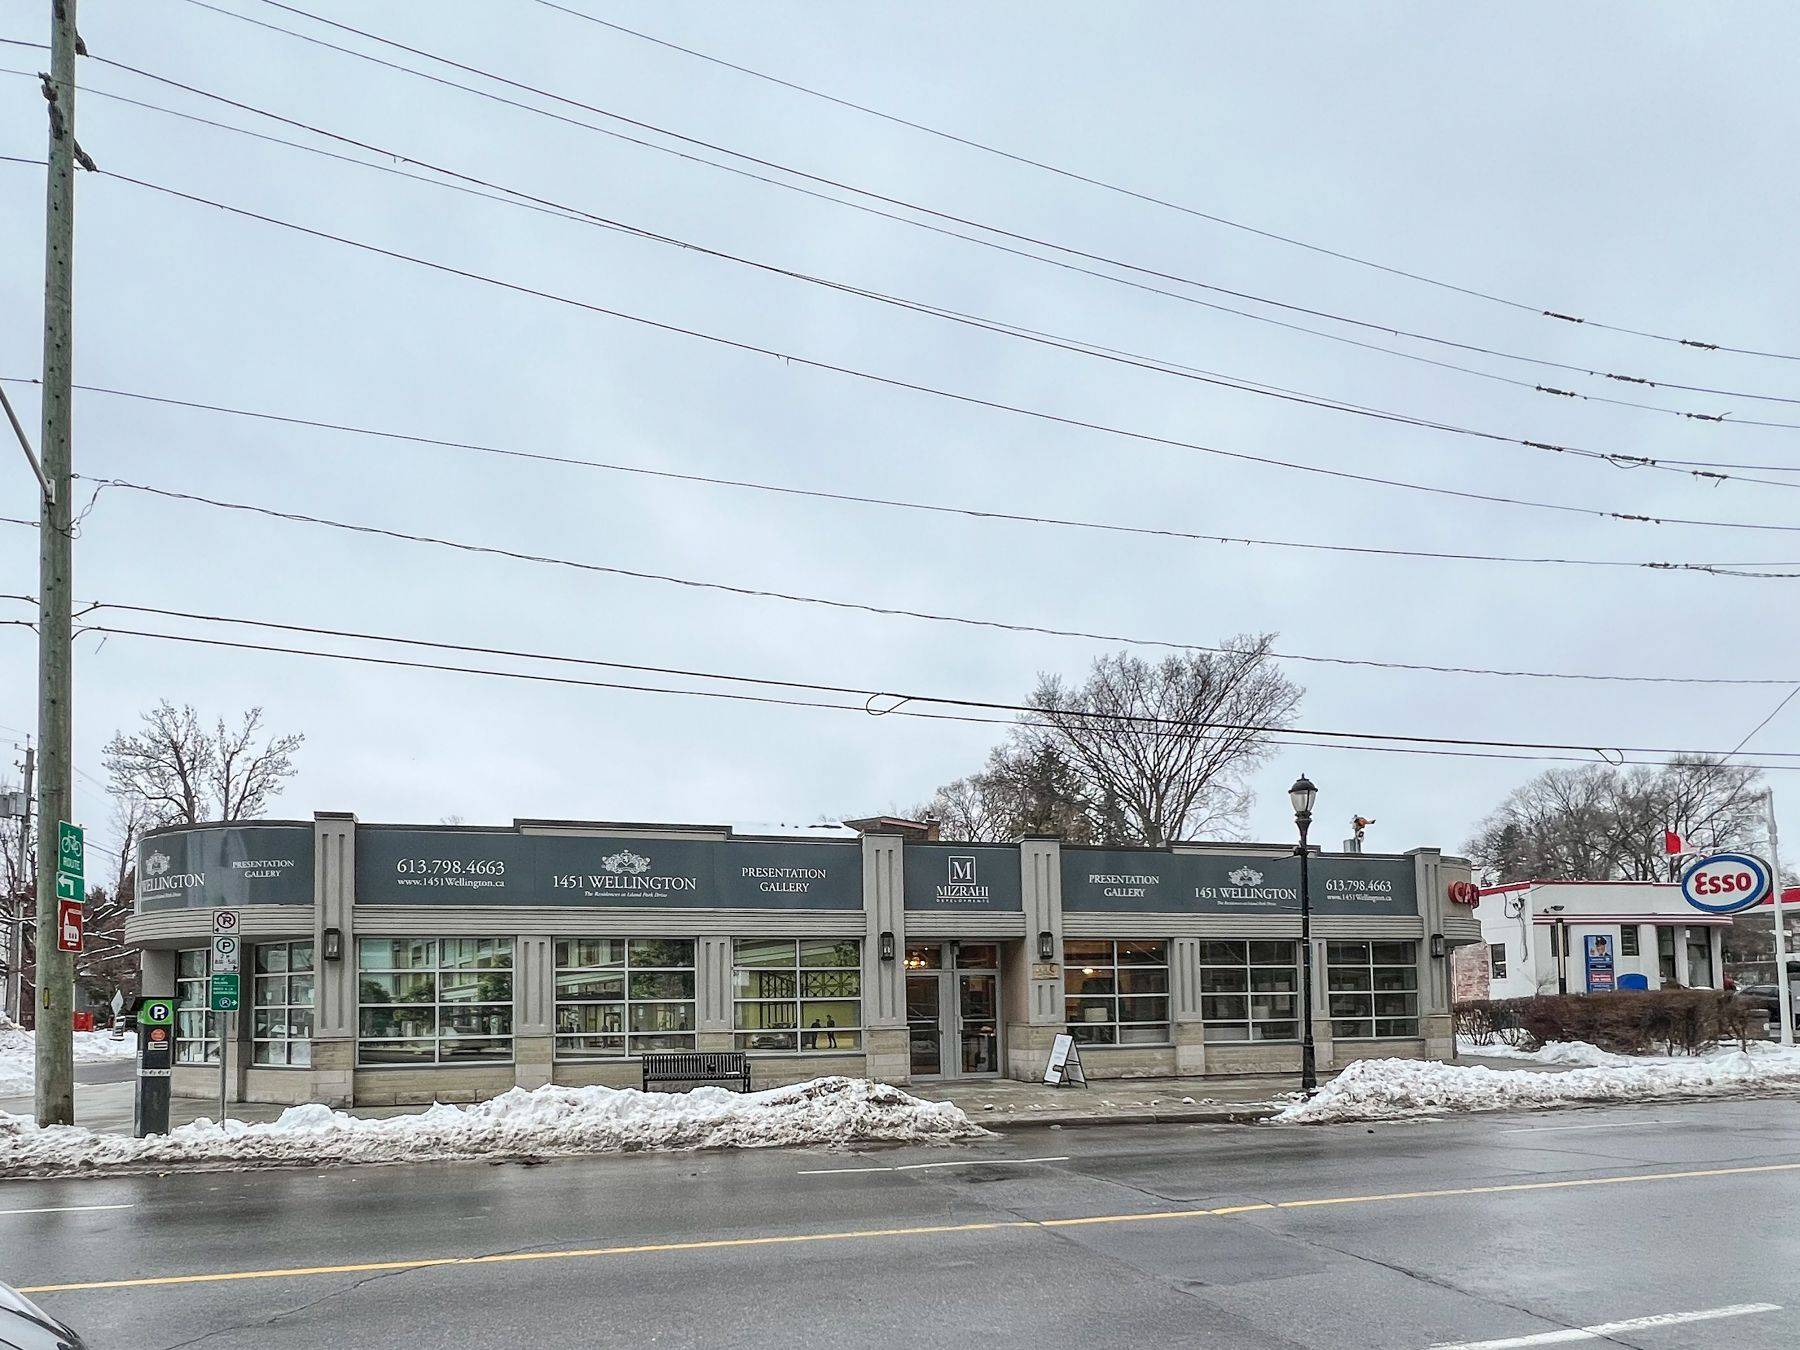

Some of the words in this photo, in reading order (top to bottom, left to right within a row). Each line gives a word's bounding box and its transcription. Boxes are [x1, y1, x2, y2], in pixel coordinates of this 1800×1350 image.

[232, 860, 295, 869] PRESENTATION
[396, 858, 505, 876] 613.798.4663
[952, 861, 972, 880] M
[244, 870, 282, 878] GALLERY
[742, 867, 827, 880] PRESENTATION
[1089, 874, 1160, 885] PRESENTATION
[397, 877, 505, 889] www.1451Wellington.ca
[553, 875, 584, 889] 1451
[588, 875, 697, 891] WELLINGTON
[759, 881, 810, 893] GALLERY
[1325, 879, 1392, 892] 613.798.4663
[936, 885, 989, 897] MIZRAHI
[1104, 886, 1146, 898] GALLERY
[1195, 887, 1217, 899] 1451
[1219, 887, 1297, 900] WELLINGTON
